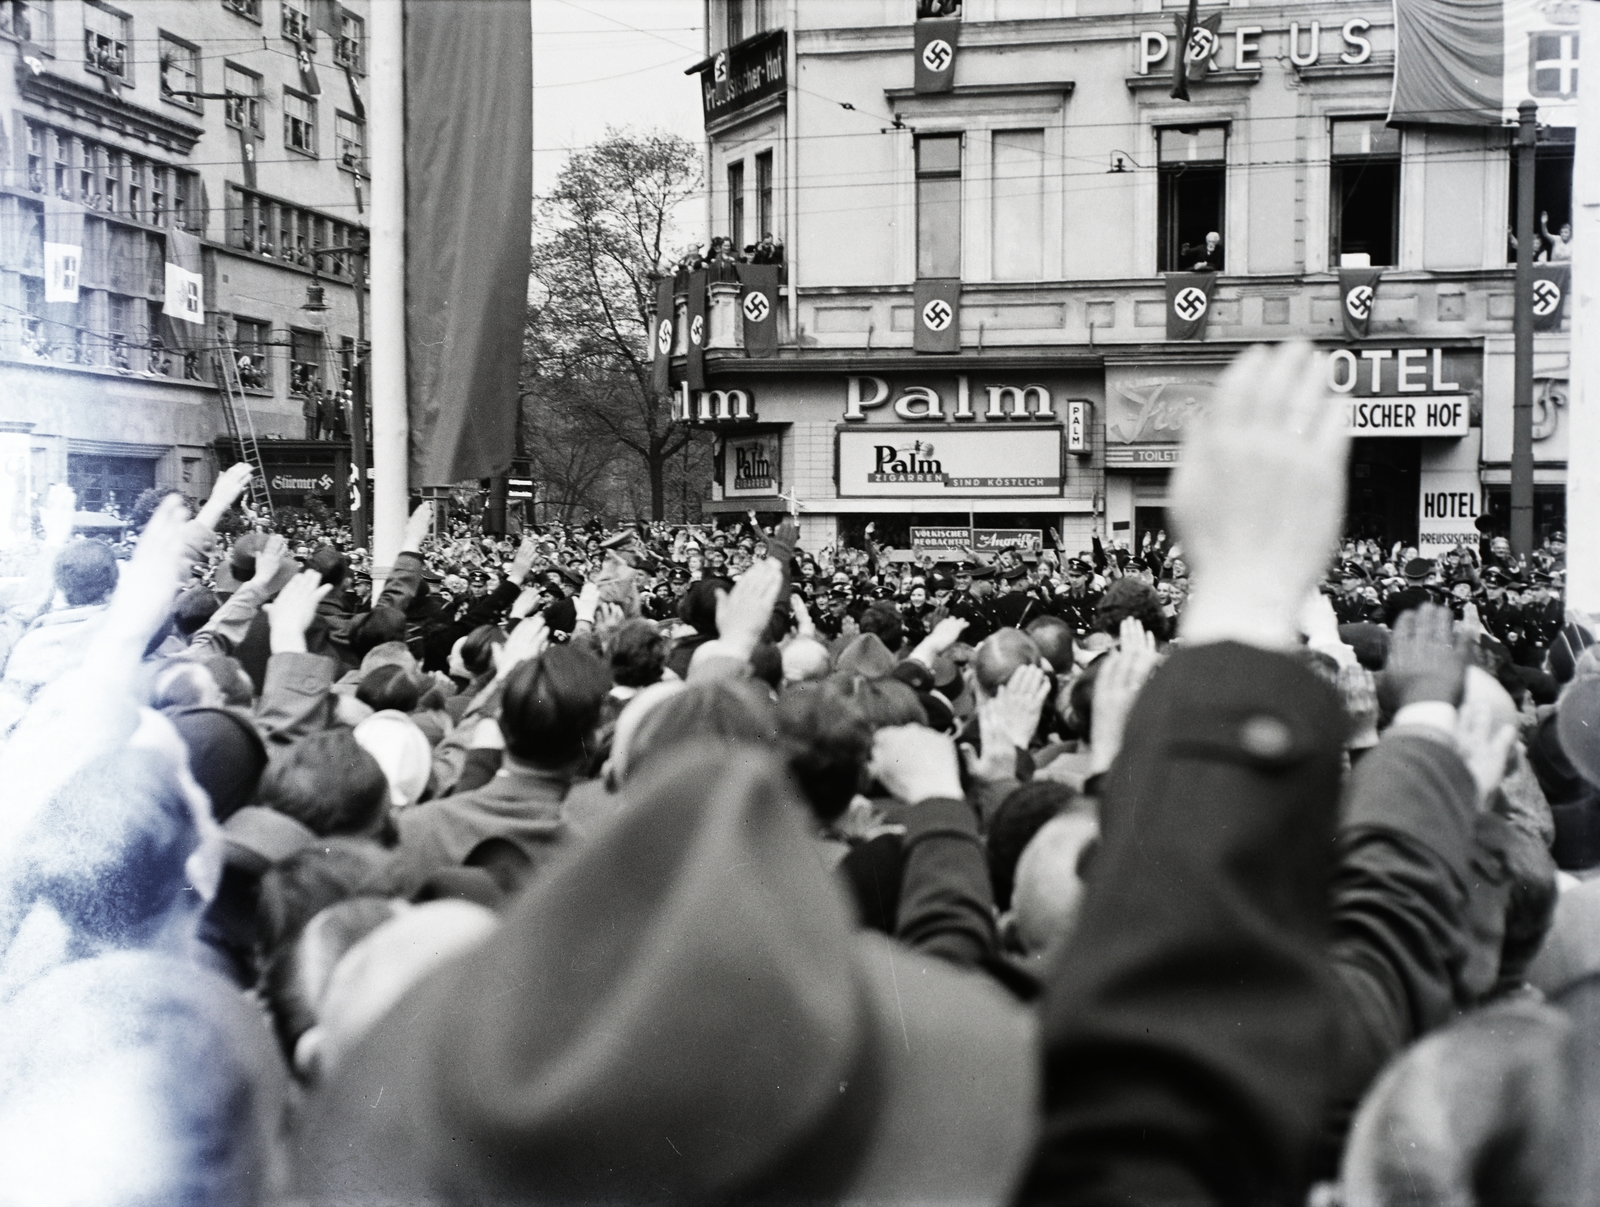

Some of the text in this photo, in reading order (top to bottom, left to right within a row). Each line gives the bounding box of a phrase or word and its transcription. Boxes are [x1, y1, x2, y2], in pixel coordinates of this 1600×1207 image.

[1325, 348, 1459, 393] OTEL
[672, 381, 751, 419] lm
[844, 375, 1056, 420] Palm
[1072, 406, 1081, 445] PALM
[1345, 403, 1462, 428] ISCHER HOF
[735, 447, 770, 479] Palm
[874, 445, 942, 474] Palm
[875, 474, 943, 482] ZIGARREN
[953, 478, 1044, 487] SIND KÖSTLICH
[1424, 492, 1478, 518] HOTEL
[1420, 532, 1479, 545] PREUSSISCHER
